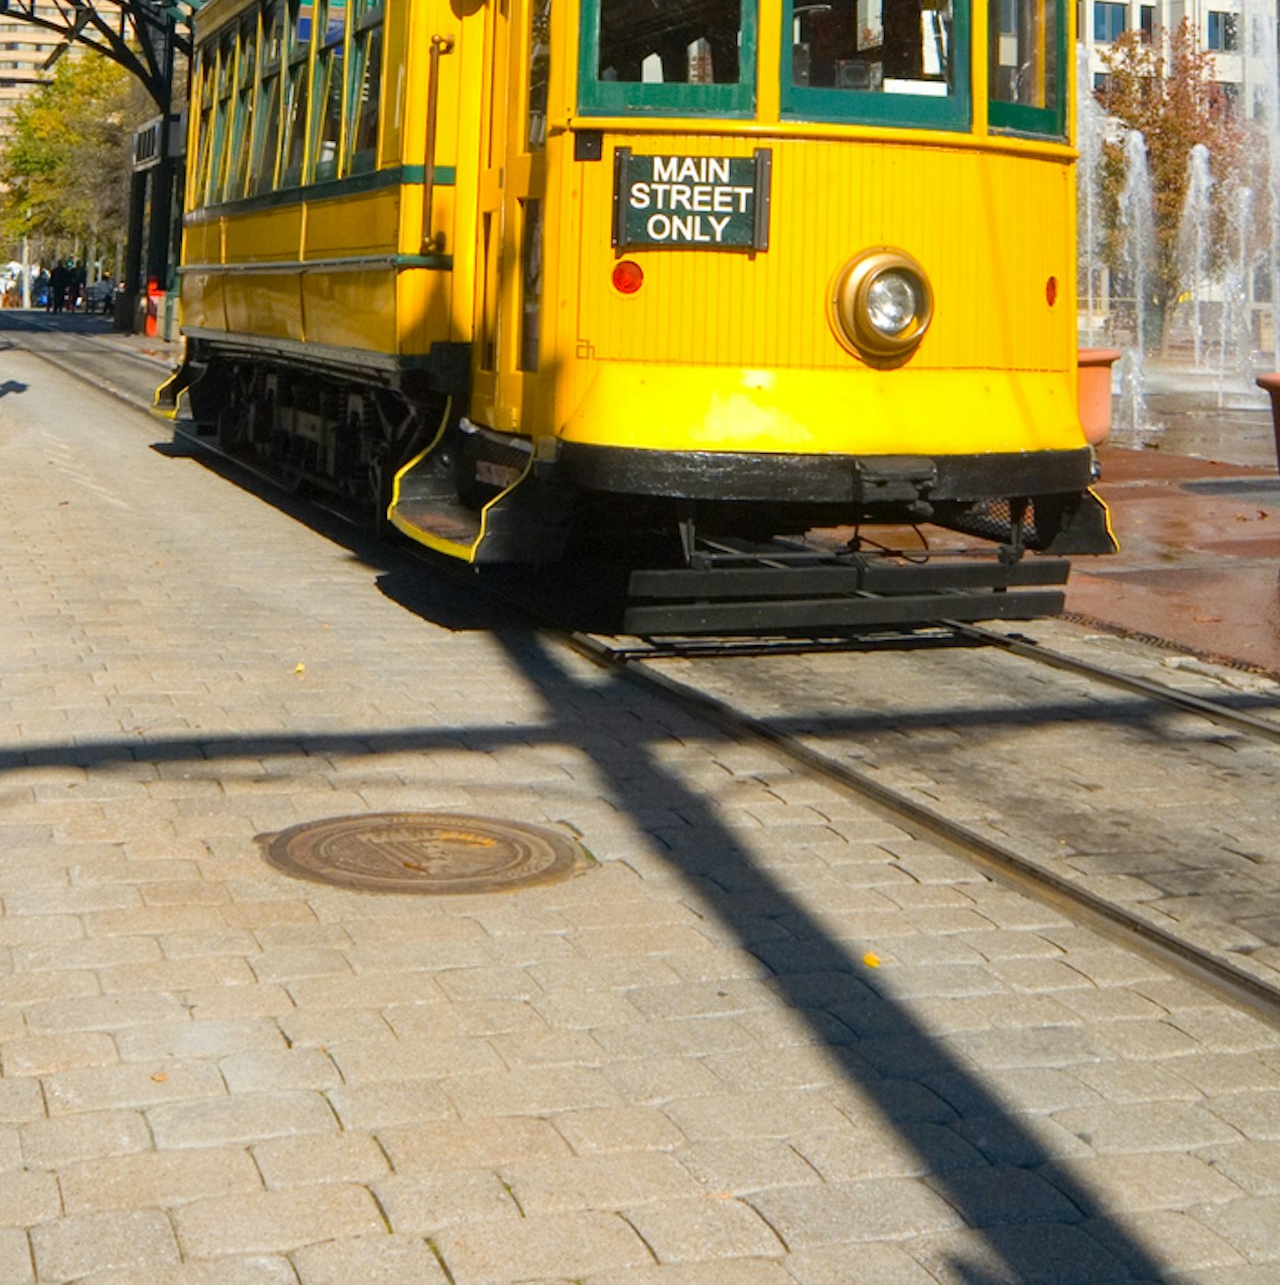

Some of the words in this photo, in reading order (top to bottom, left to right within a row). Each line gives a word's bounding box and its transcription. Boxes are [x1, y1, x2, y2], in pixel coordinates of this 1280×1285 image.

[653, 156, 730, 184] MAIN
[629, 182, 754, 213] STREET
[646, 213, 731, 242] ONLY
